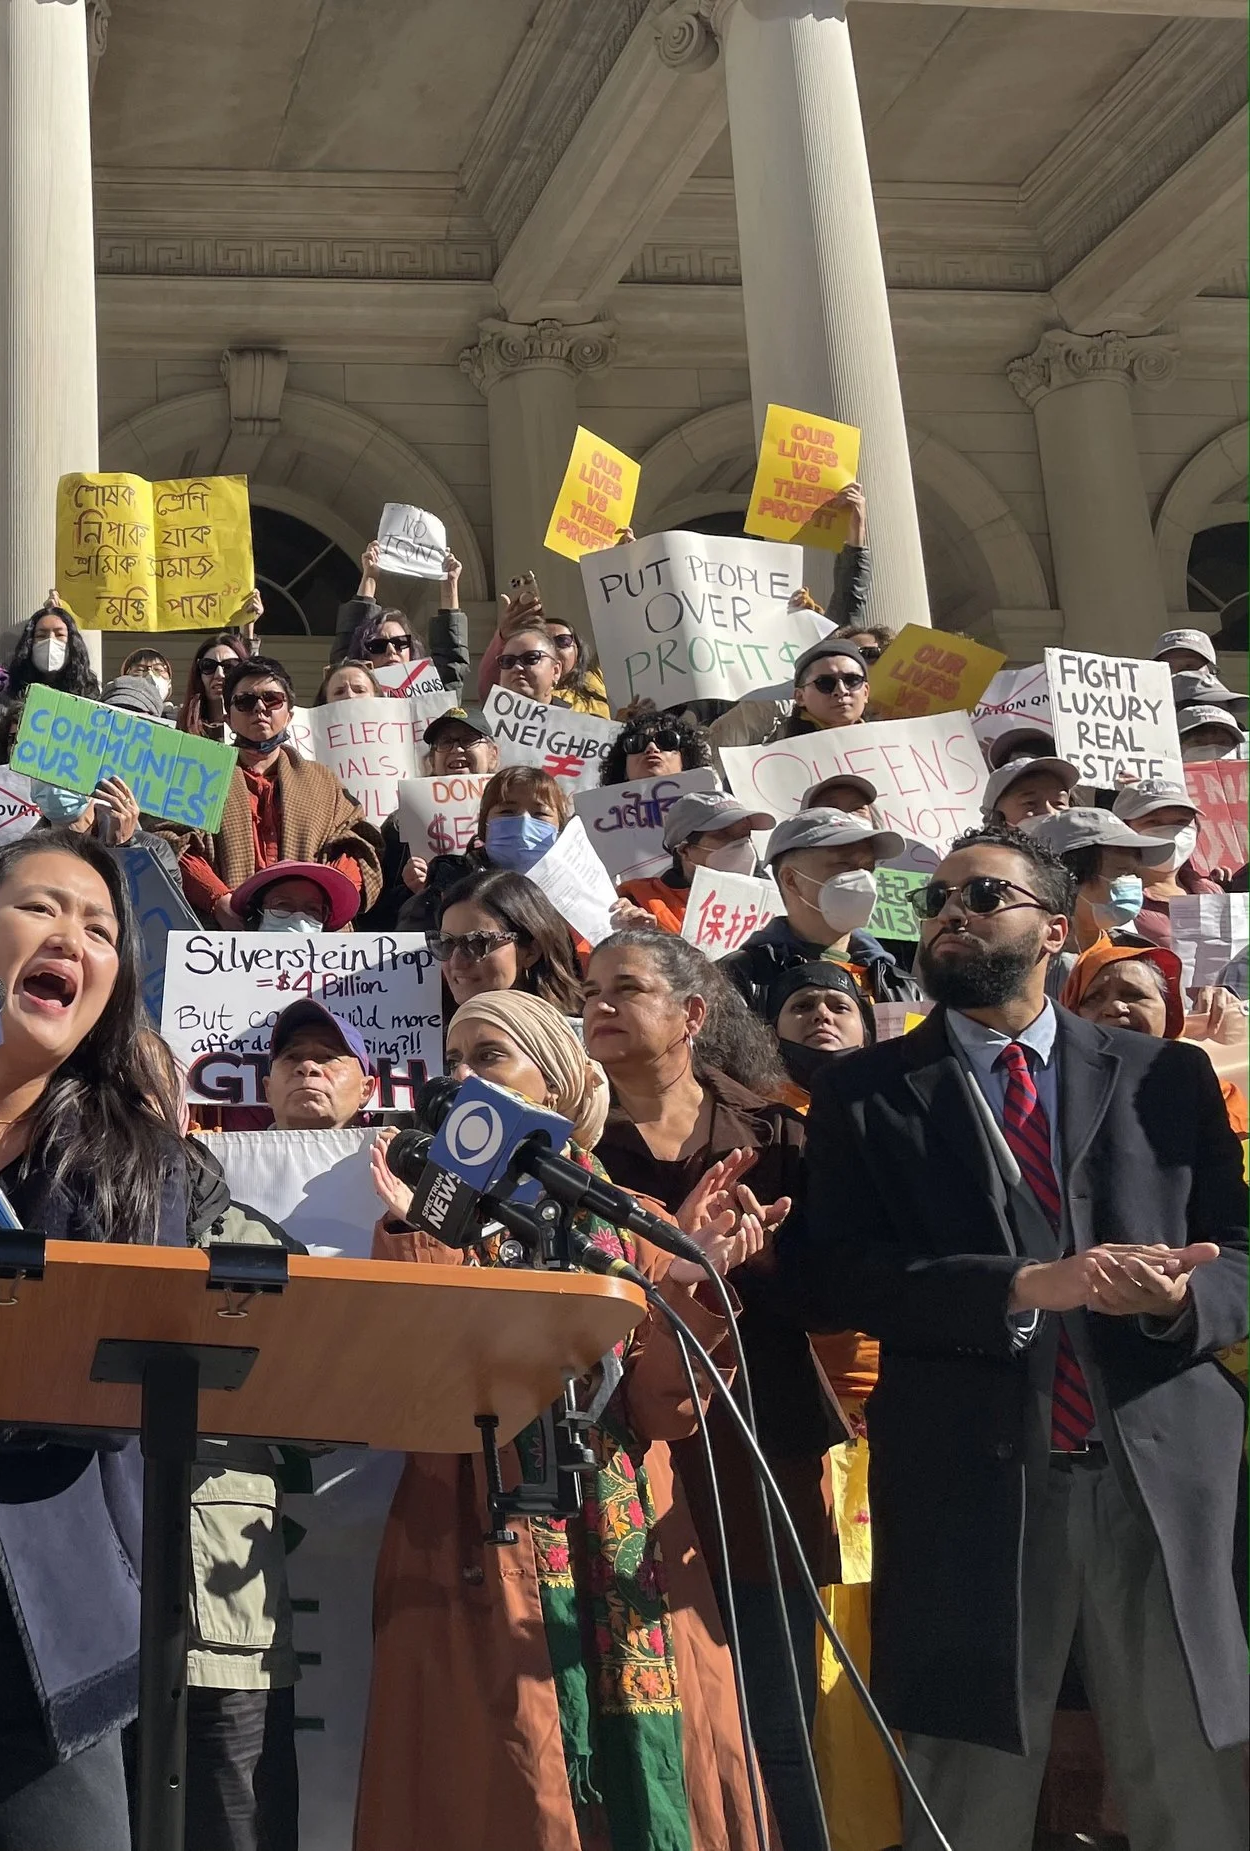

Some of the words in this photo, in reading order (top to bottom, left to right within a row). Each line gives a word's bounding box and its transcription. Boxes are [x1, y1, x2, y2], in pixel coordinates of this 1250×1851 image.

[791, 423, 834, 449] OUR
[592, 450, 622, 482] OUR
[778, 439, 838, 468] LIVES
[579, 463, 622, 501] LIVES
[792, 461, 820, 483] VS
[587, 487, 608, 512] VS
[570, 500, 616, 539] THEIR
[600, 558, 670, 603] PUT
[685, 555, 789, 600] PEOPLE
[645, 590, 752, 633] OVER
[1059, 655, 1139, 693] FIGHT
[493, 690, 548, 722] OUR
[1030, 694, 1050, 706] QN
[1057, 691, 1163, 725] LUXURY
[90, 710, 154, 747] OUR
[1077, 721, 1145, 752] REAL
[17, 740, 80, 783] OUR
[884, 807, 966, 838] NOT
[184, 935, 372, 975] Silverstein
[321, 973, 388, 999] Billion
[174, 1003, 233, 1031] But
[391, 1014, 442, 1029] more
[422, 1172, 445, 1219] SPECTRUM
